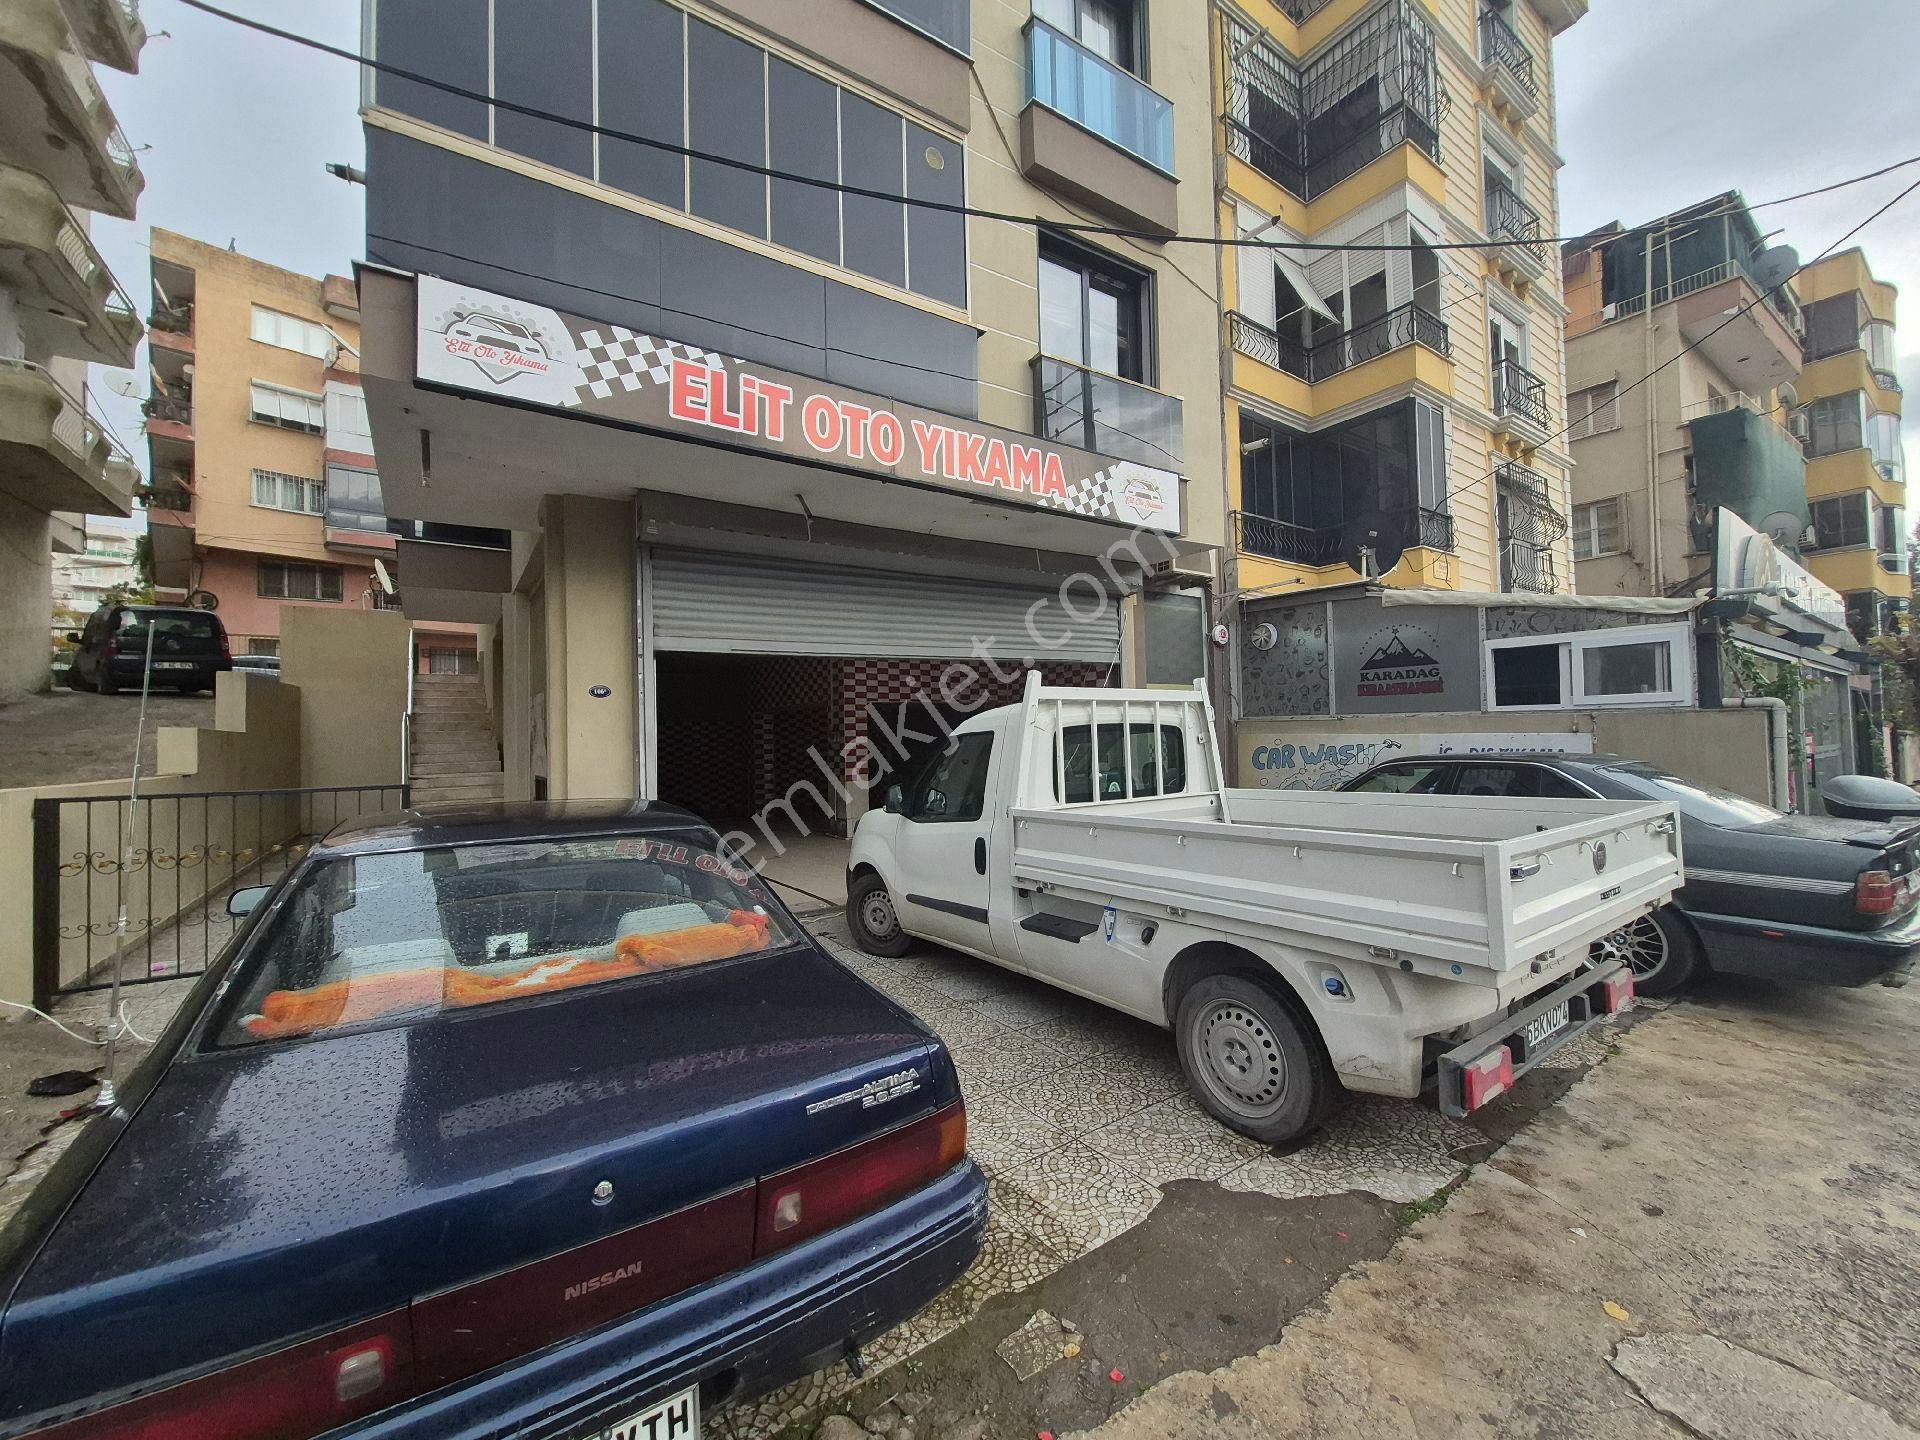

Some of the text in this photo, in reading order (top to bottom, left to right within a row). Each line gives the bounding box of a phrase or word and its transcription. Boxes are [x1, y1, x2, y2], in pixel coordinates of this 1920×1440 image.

[802, 394, 905, 467] OTO
[911, 419, 1068, 498] YIKAMA
[1252, 744, 1375, 770] CAR WASH
[564, 1261, 642, 1301] NISSAN
